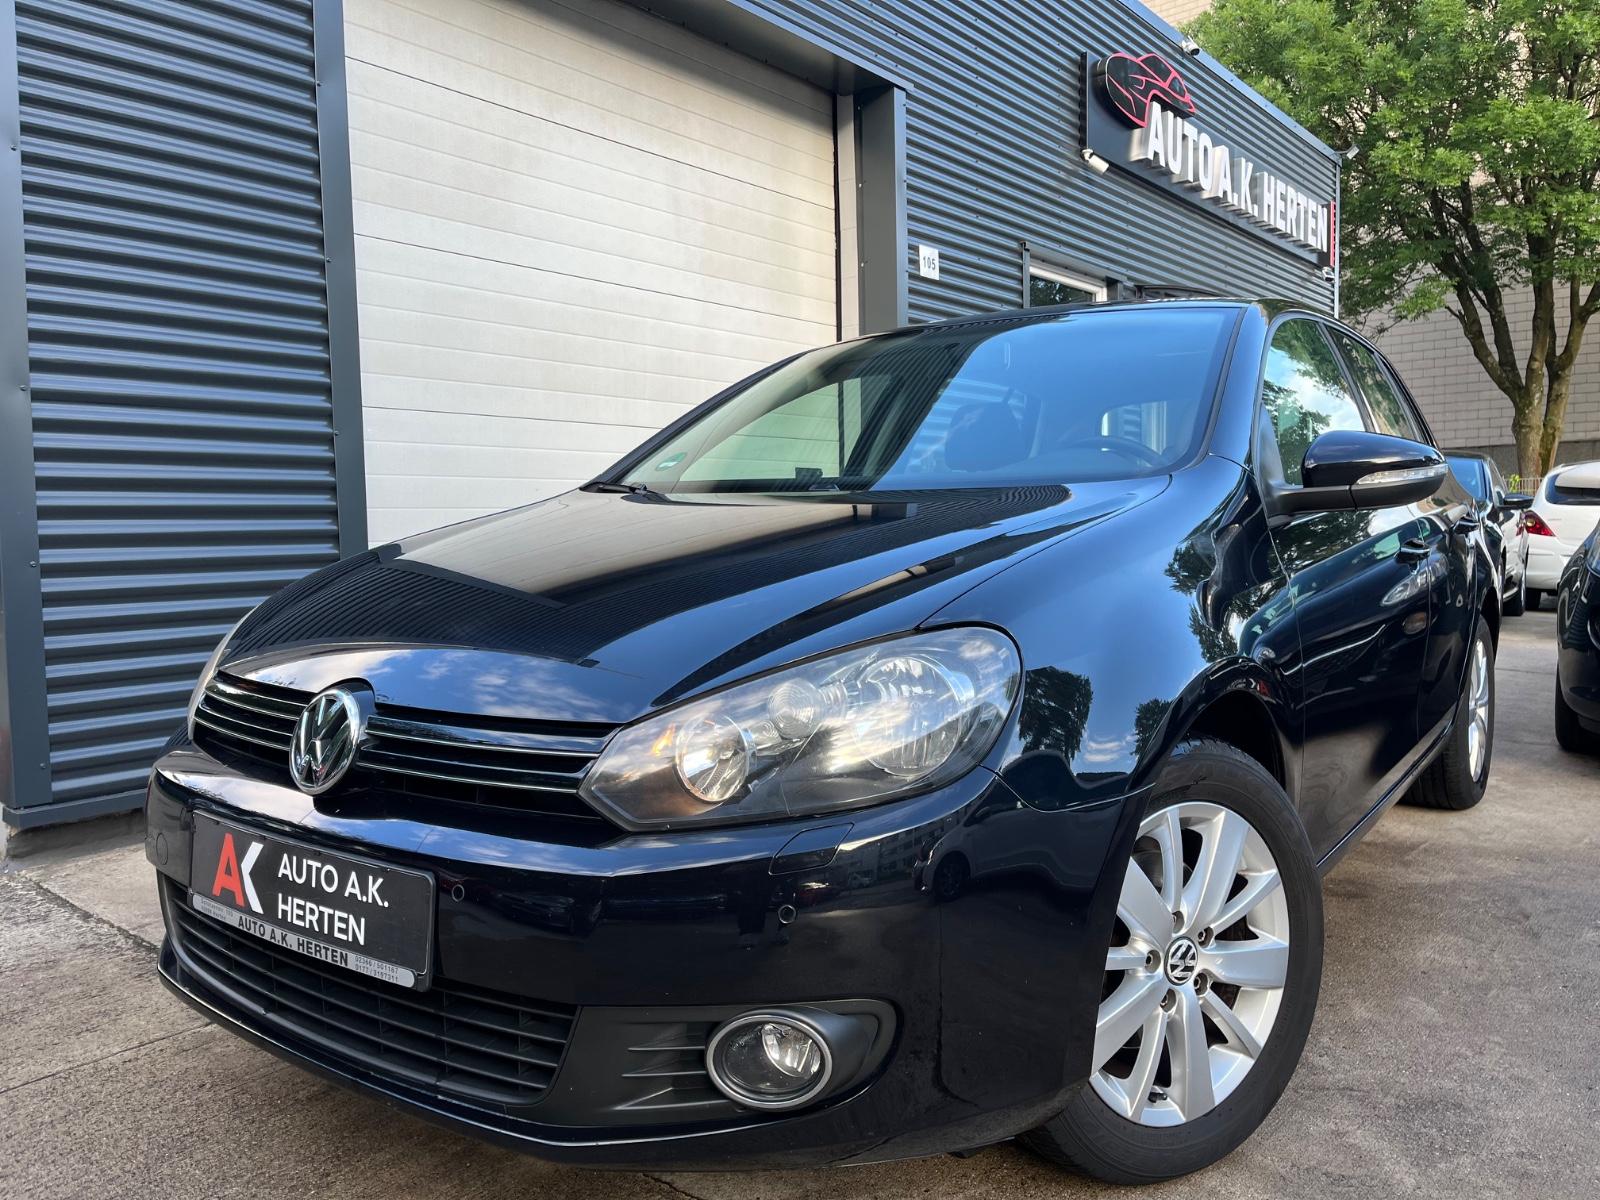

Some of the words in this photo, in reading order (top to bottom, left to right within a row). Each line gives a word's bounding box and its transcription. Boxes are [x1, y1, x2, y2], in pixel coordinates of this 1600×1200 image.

[1147, 101, 1213, 191] AUTO
[1218, 145, 1259, 217] A.K.
[1264, 171, 1328, 253] HERTEN
[923, 257, 936, 270] 105
[278, 854, 338, 893] AUTO
[344, 871, 389, 907] A.K.
[238, 916, 266, 937] AUTO
[270, 929, 293, 948] A.K.
[297, 939, 348, 967] HERTEN
[278, 893, 365, 945] HERTEN
